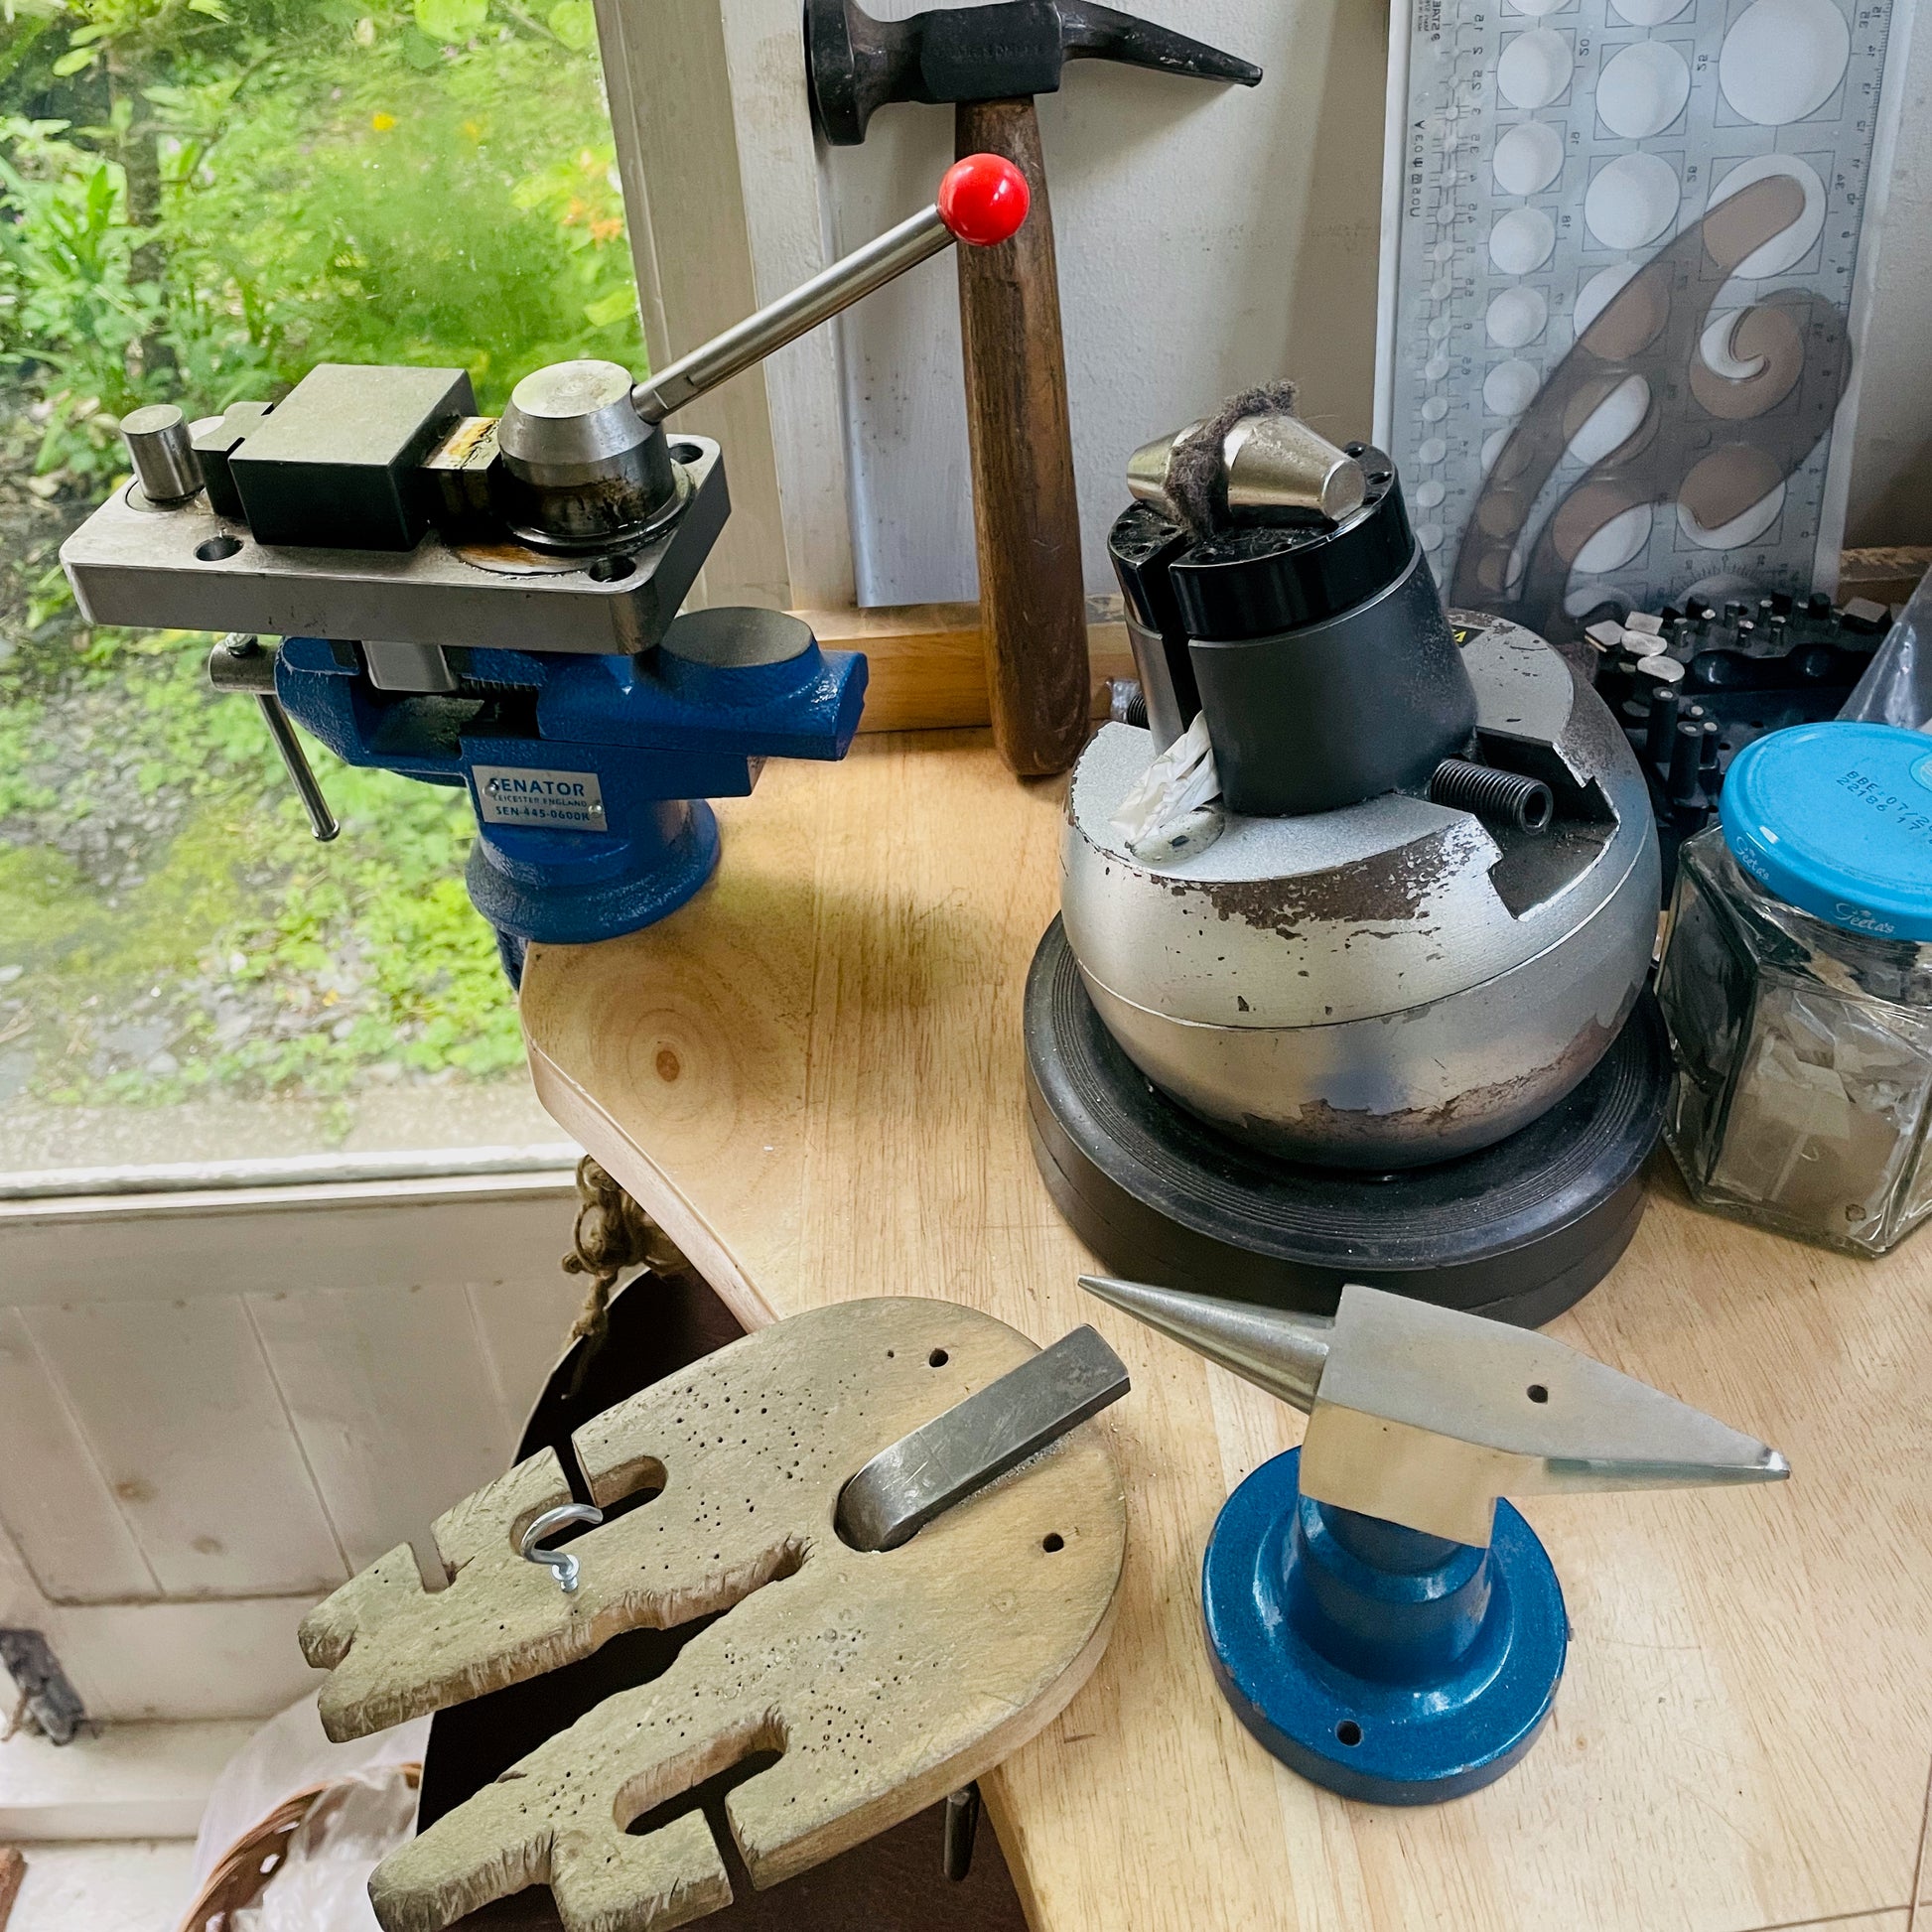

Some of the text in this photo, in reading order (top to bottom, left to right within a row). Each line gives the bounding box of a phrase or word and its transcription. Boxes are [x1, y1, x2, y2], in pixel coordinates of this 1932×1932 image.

[489, 777, 585, 797] SENATOR
[543, 798, 588, 808] ENGLAND
[1835, 902, 1895, 934] Geeta's
